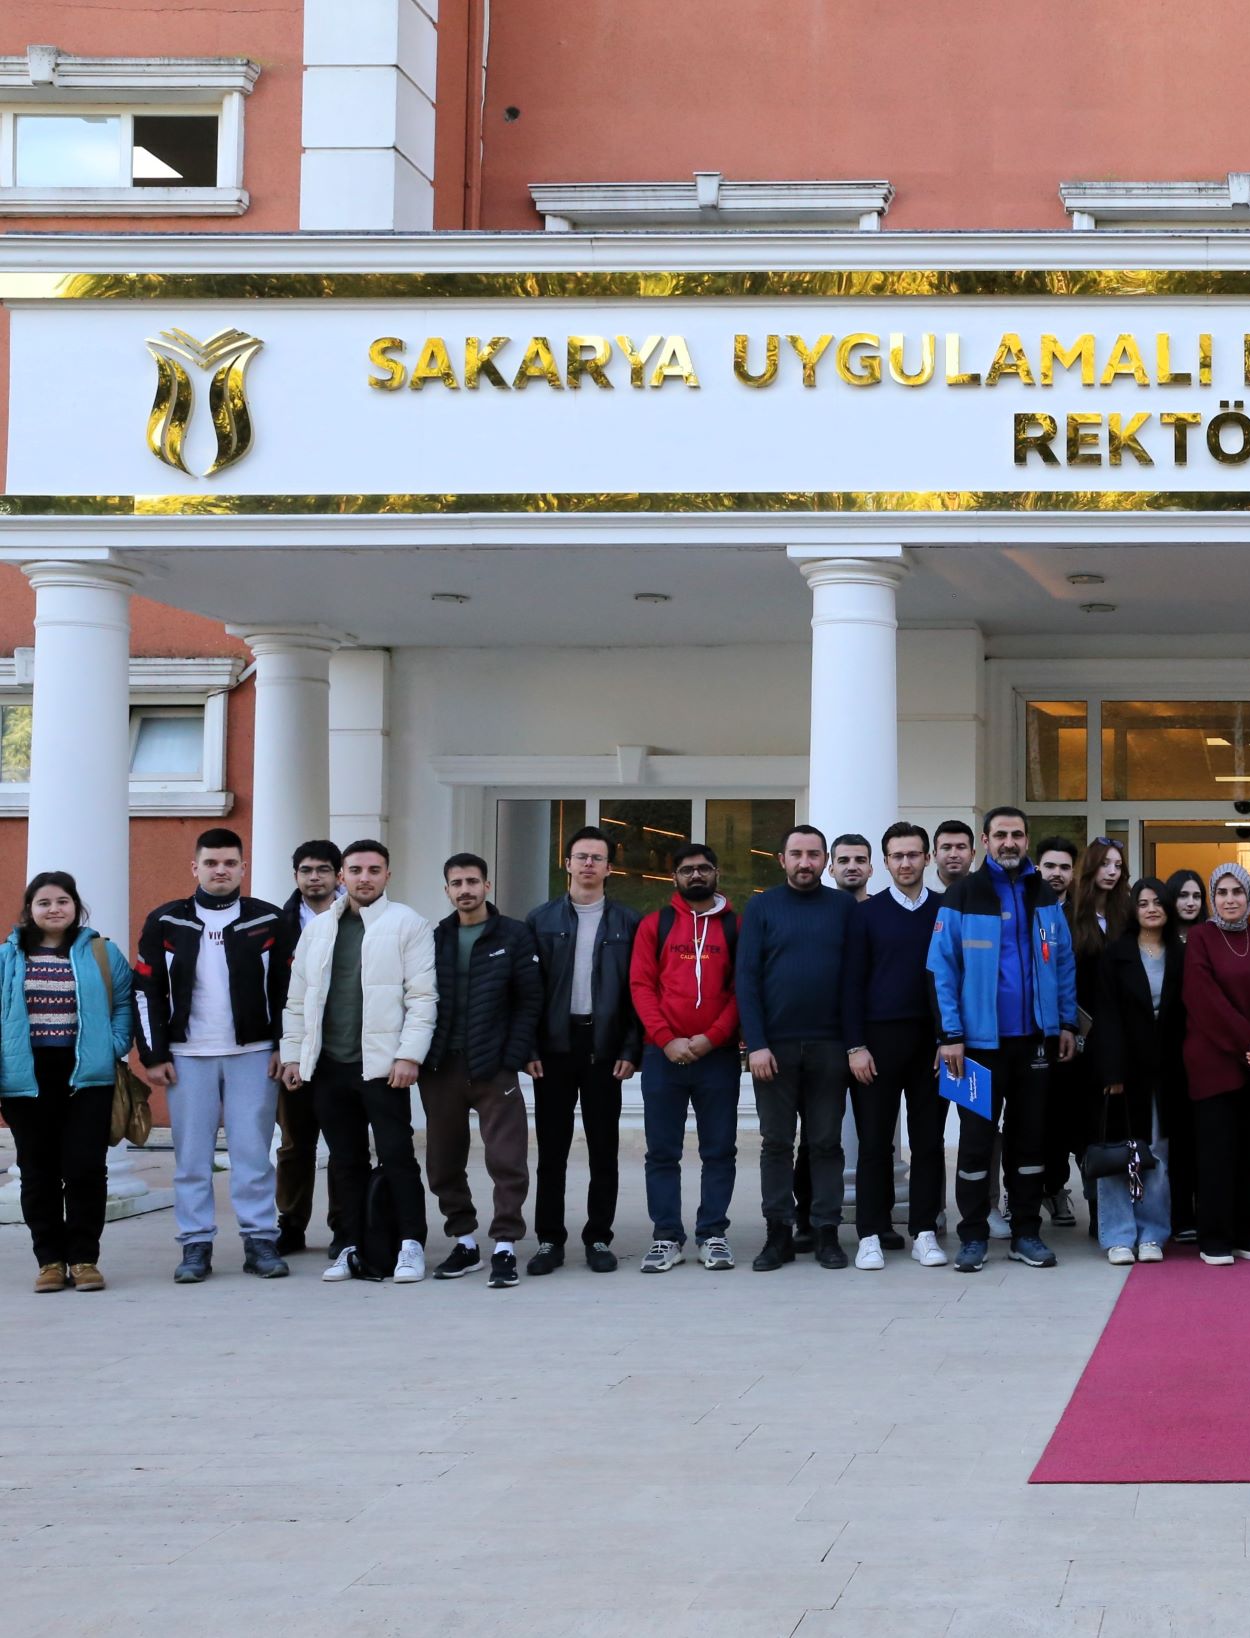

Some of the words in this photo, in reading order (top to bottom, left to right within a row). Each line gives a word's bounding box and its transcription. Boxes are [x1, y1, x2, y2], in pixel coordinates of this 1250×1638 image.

[368, 335, 702, 394] SAKARYA
[733, 332, 1214, 391] UYGULAMALI
[208, 931, 224, 940] VIV
[670, 944, 721, 954] HOLLTER
